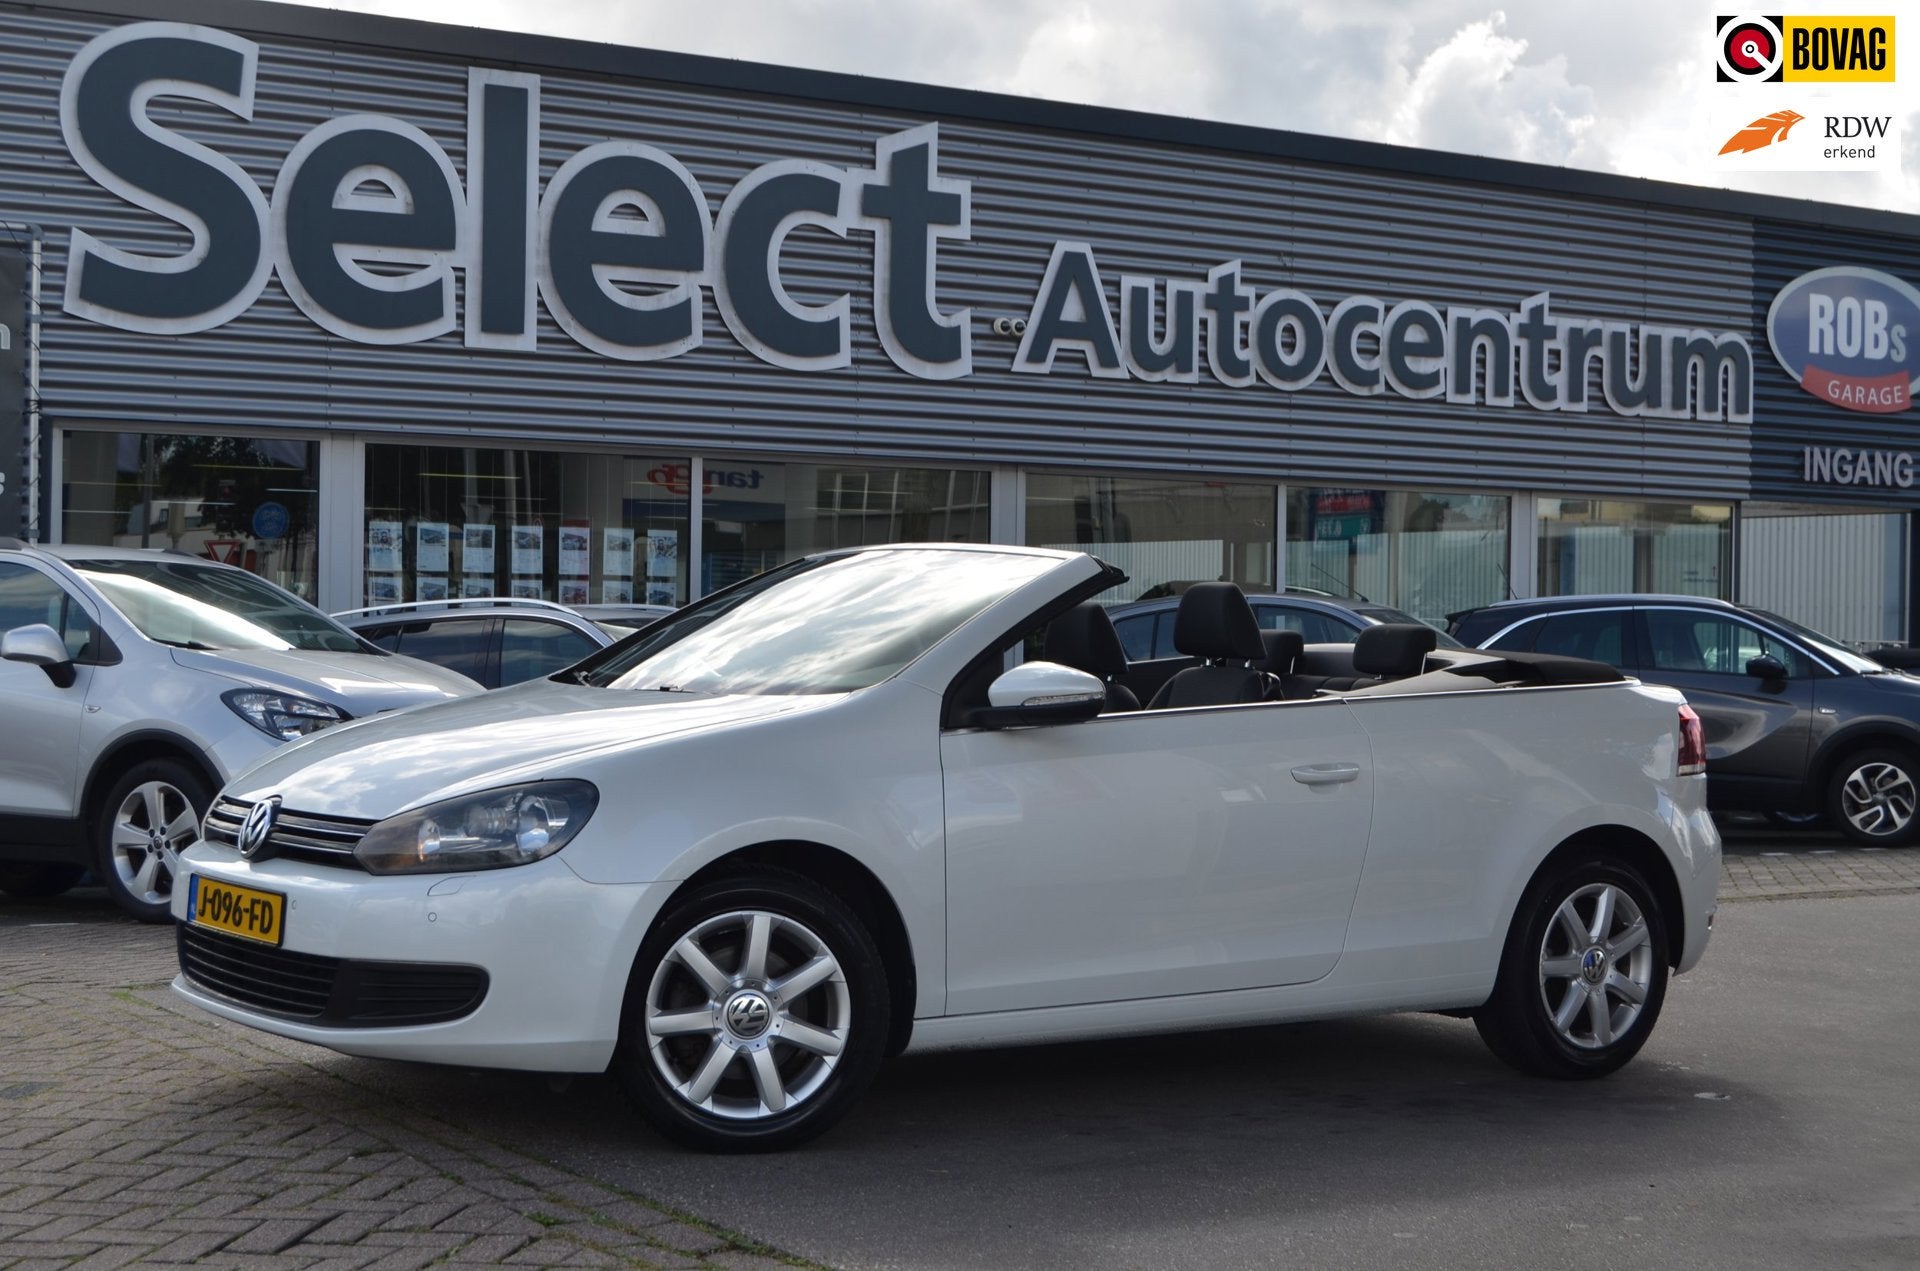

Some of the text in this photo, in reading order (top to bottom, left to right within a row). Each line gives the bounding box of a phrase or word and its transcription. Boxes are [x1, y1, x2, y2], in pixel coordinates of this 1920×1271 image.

[60, 21, 1754, 424] Select Autocentrum
[1827, 379, 1904, 405] GARAGE
[1804, 446, 1914, 488] INGANG
[198, 885, 274, 934] J-096-FD
